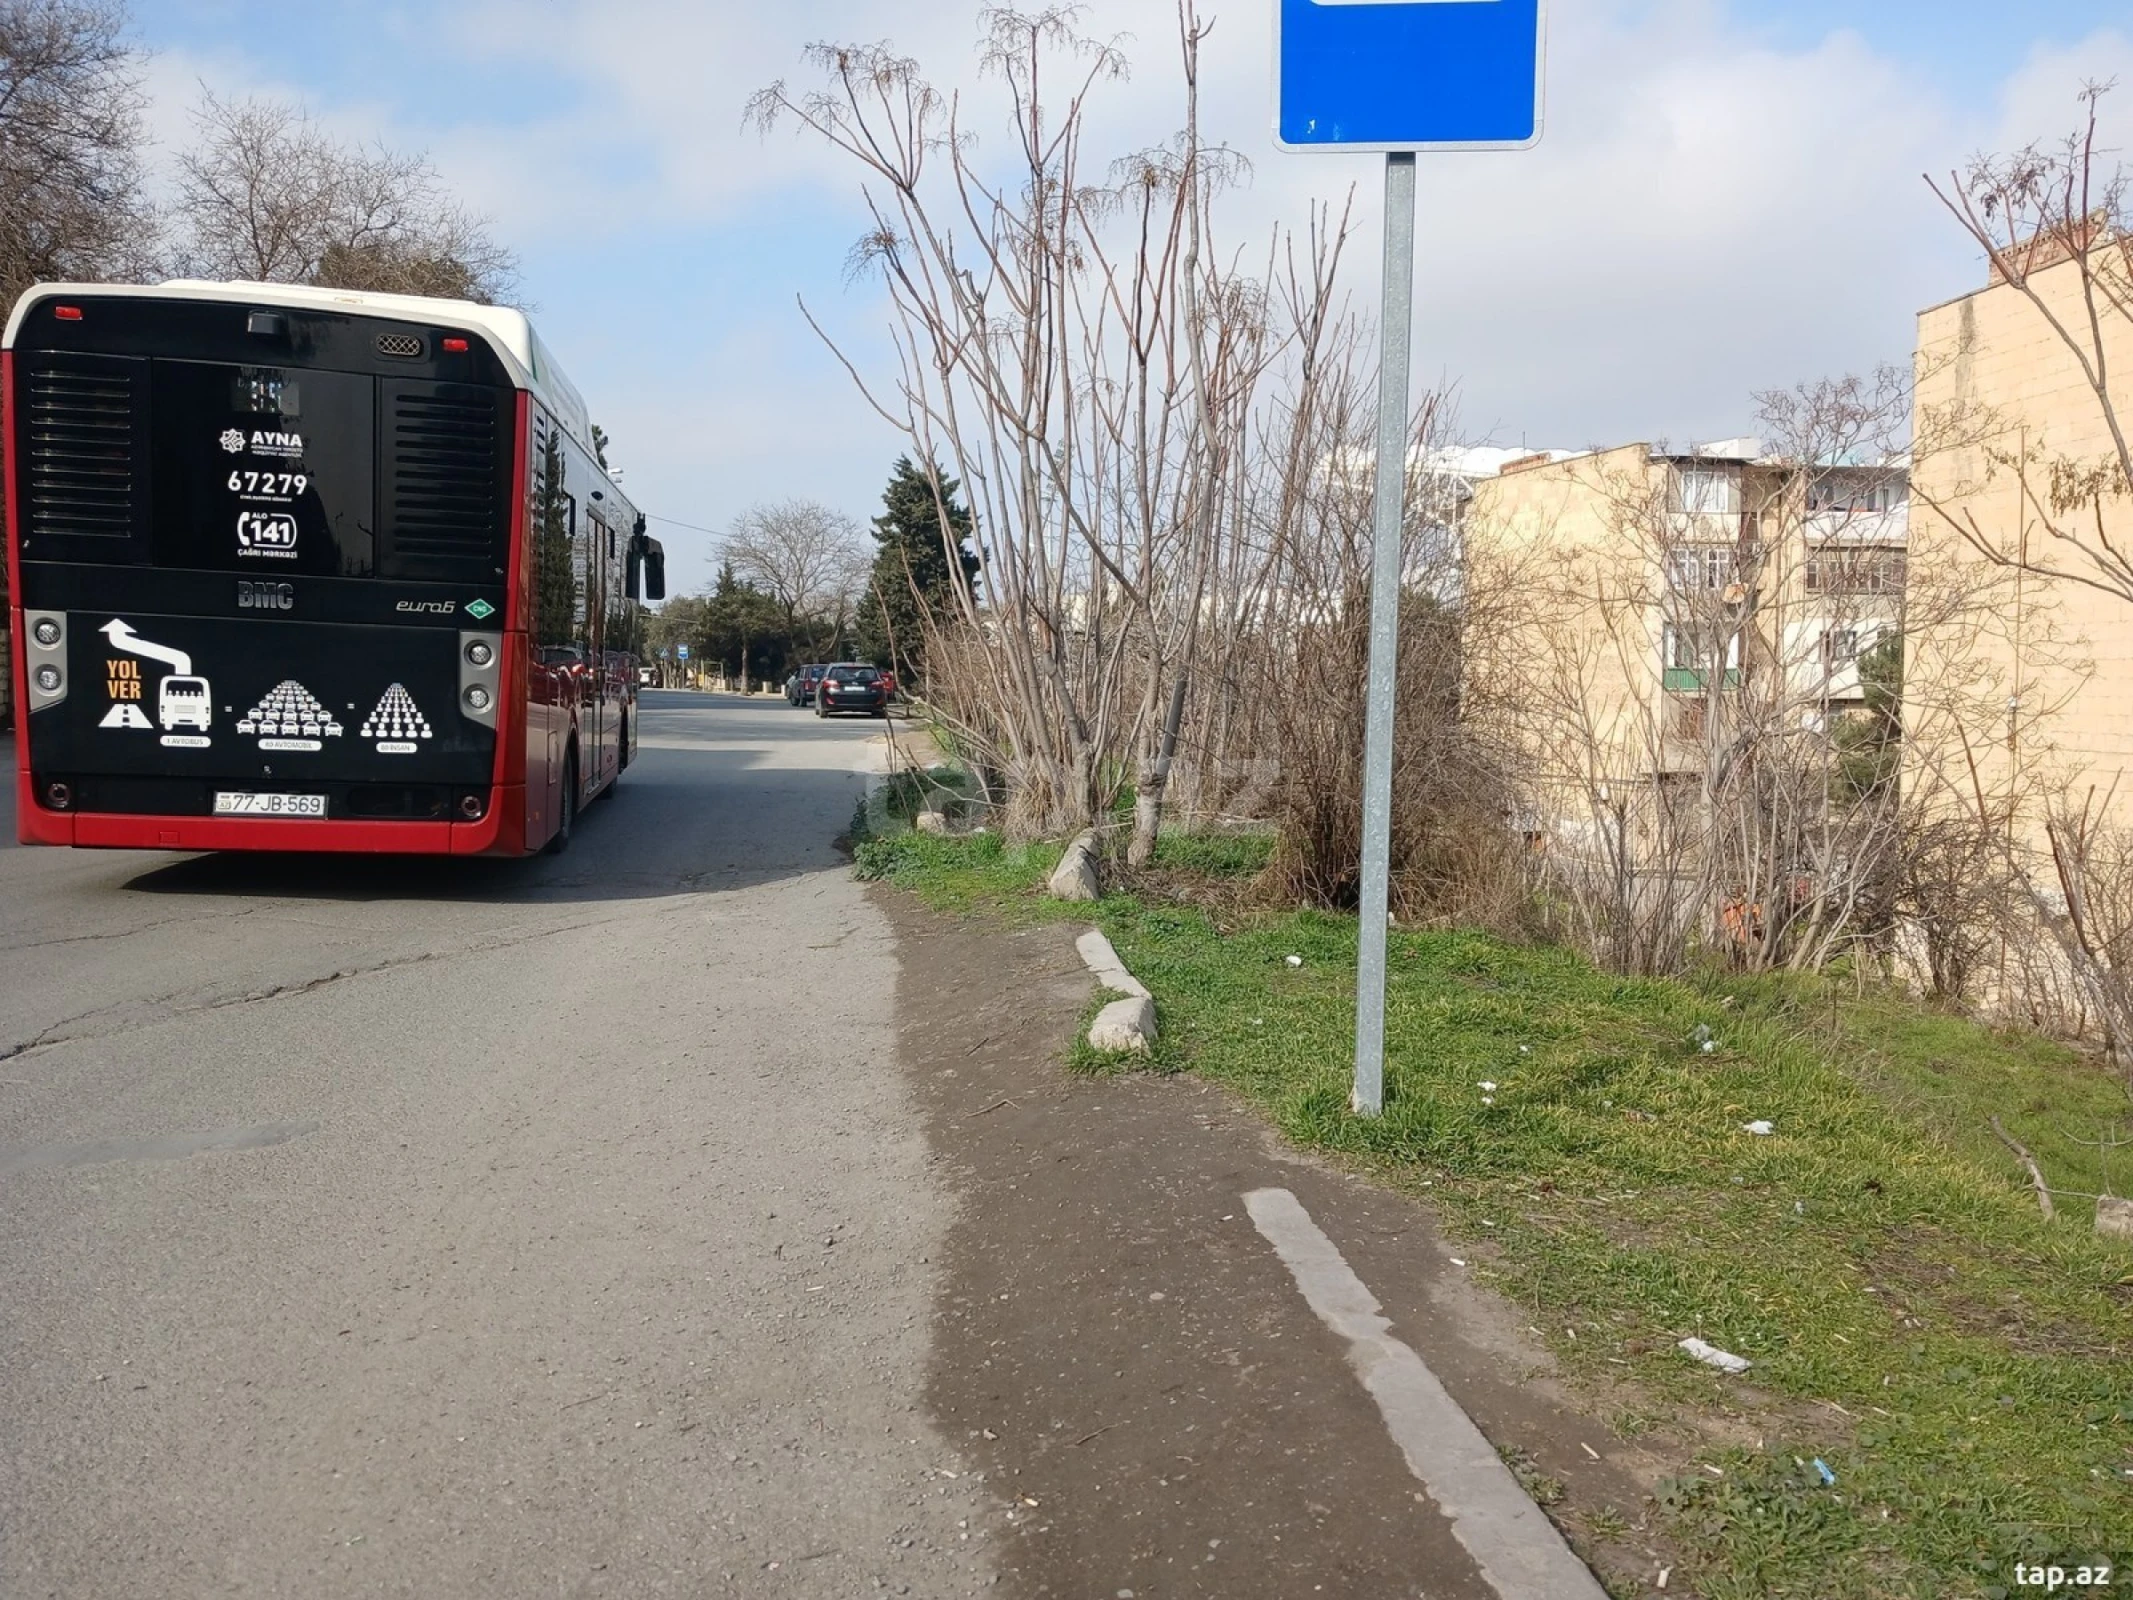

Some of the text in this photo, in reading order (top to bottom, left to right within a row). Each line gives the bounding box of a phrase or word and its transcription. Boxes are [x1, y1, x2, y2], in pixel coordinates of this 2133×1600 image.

[251, 431, 303, 447] AYNA
[228, 470, 307, 495] 67279
[250, 520, 290, 543] 141
[238, 580, 293, 610] BMC
[396, 600, 456, 614] euro6
[107, 660, 142, 679] YOL
[107, 680, 142, 699] VER
[233, 795, 321, 813] 77-JB-569
